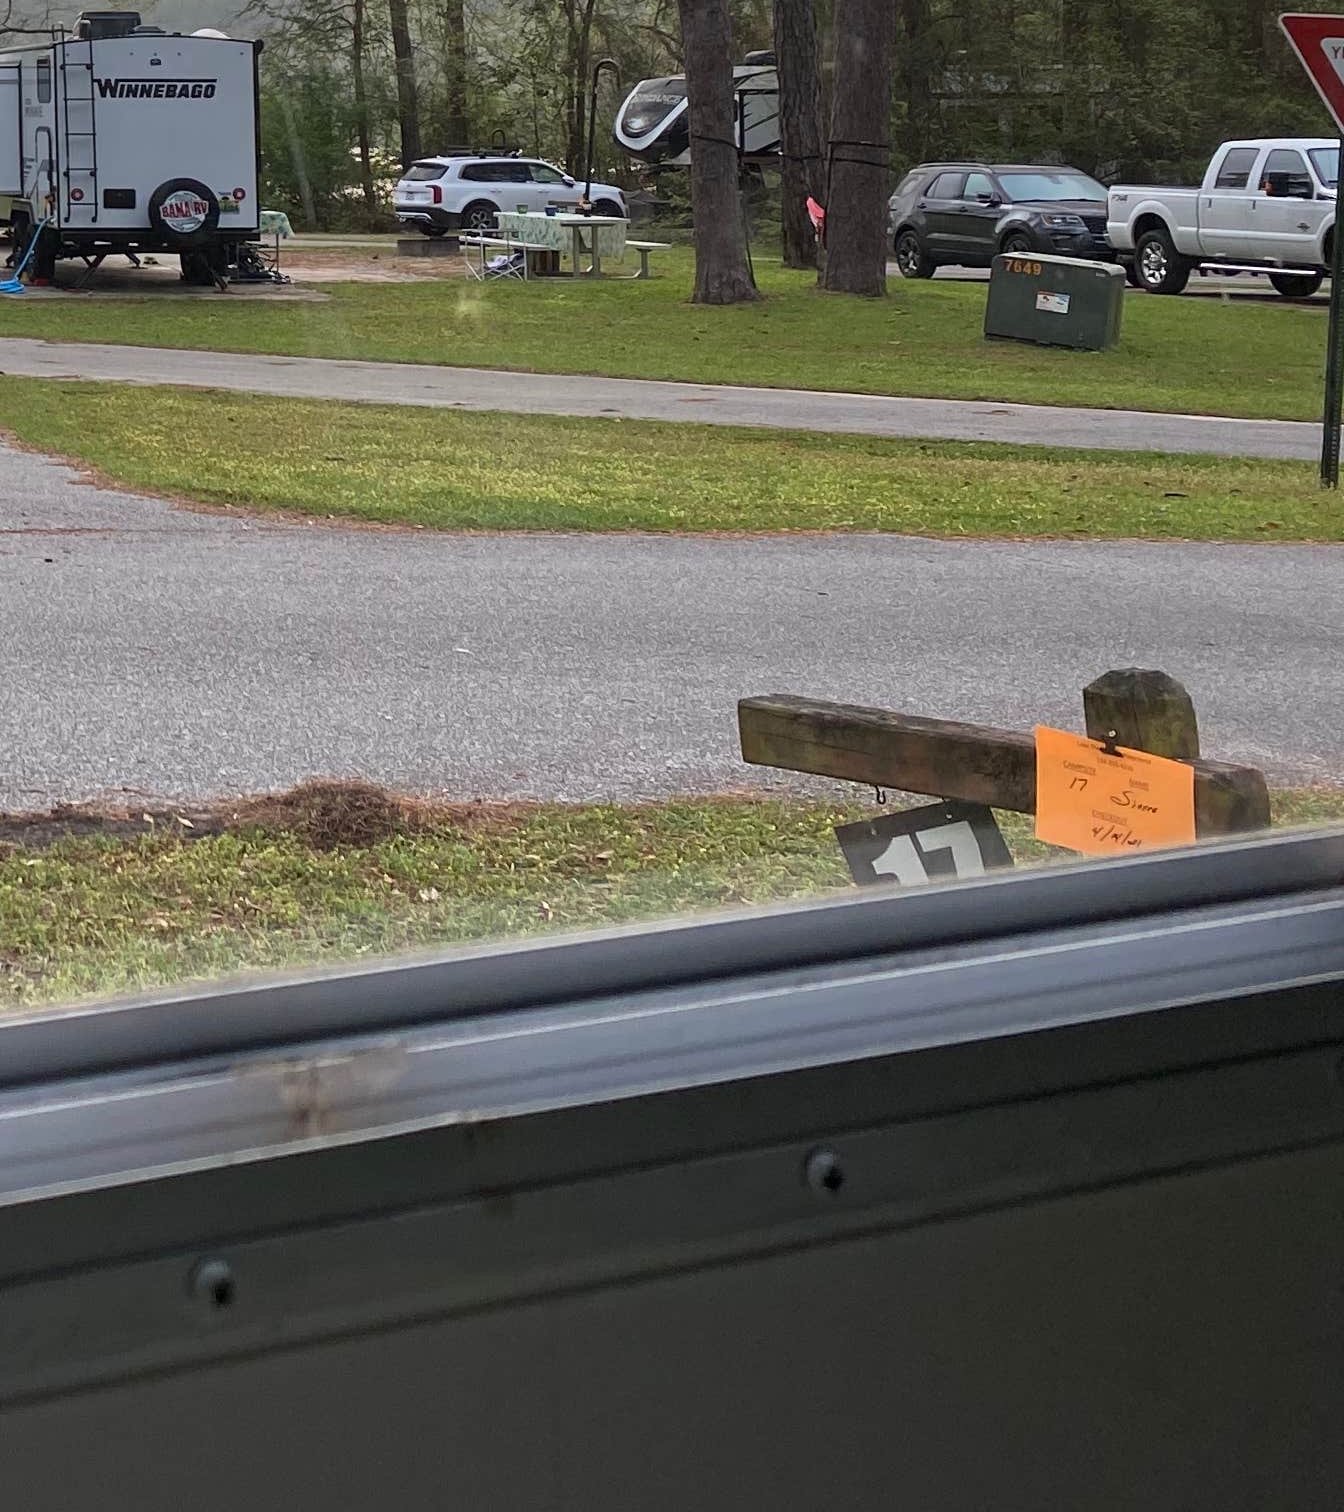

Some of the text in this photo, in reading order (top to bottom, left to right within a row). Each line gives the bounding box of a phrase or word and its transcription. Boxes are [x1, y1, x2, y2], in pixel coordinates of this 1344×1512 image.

[95, 78, 217, 99] WINNEBAGO
[161, 201, 193, 219] BAMA
[193, 200, 209, 216] RV
[1004, 259, 1042, 276] 7649
[1069, 777, 1088, 791] 17
[872, 820, 985, 887] 17
